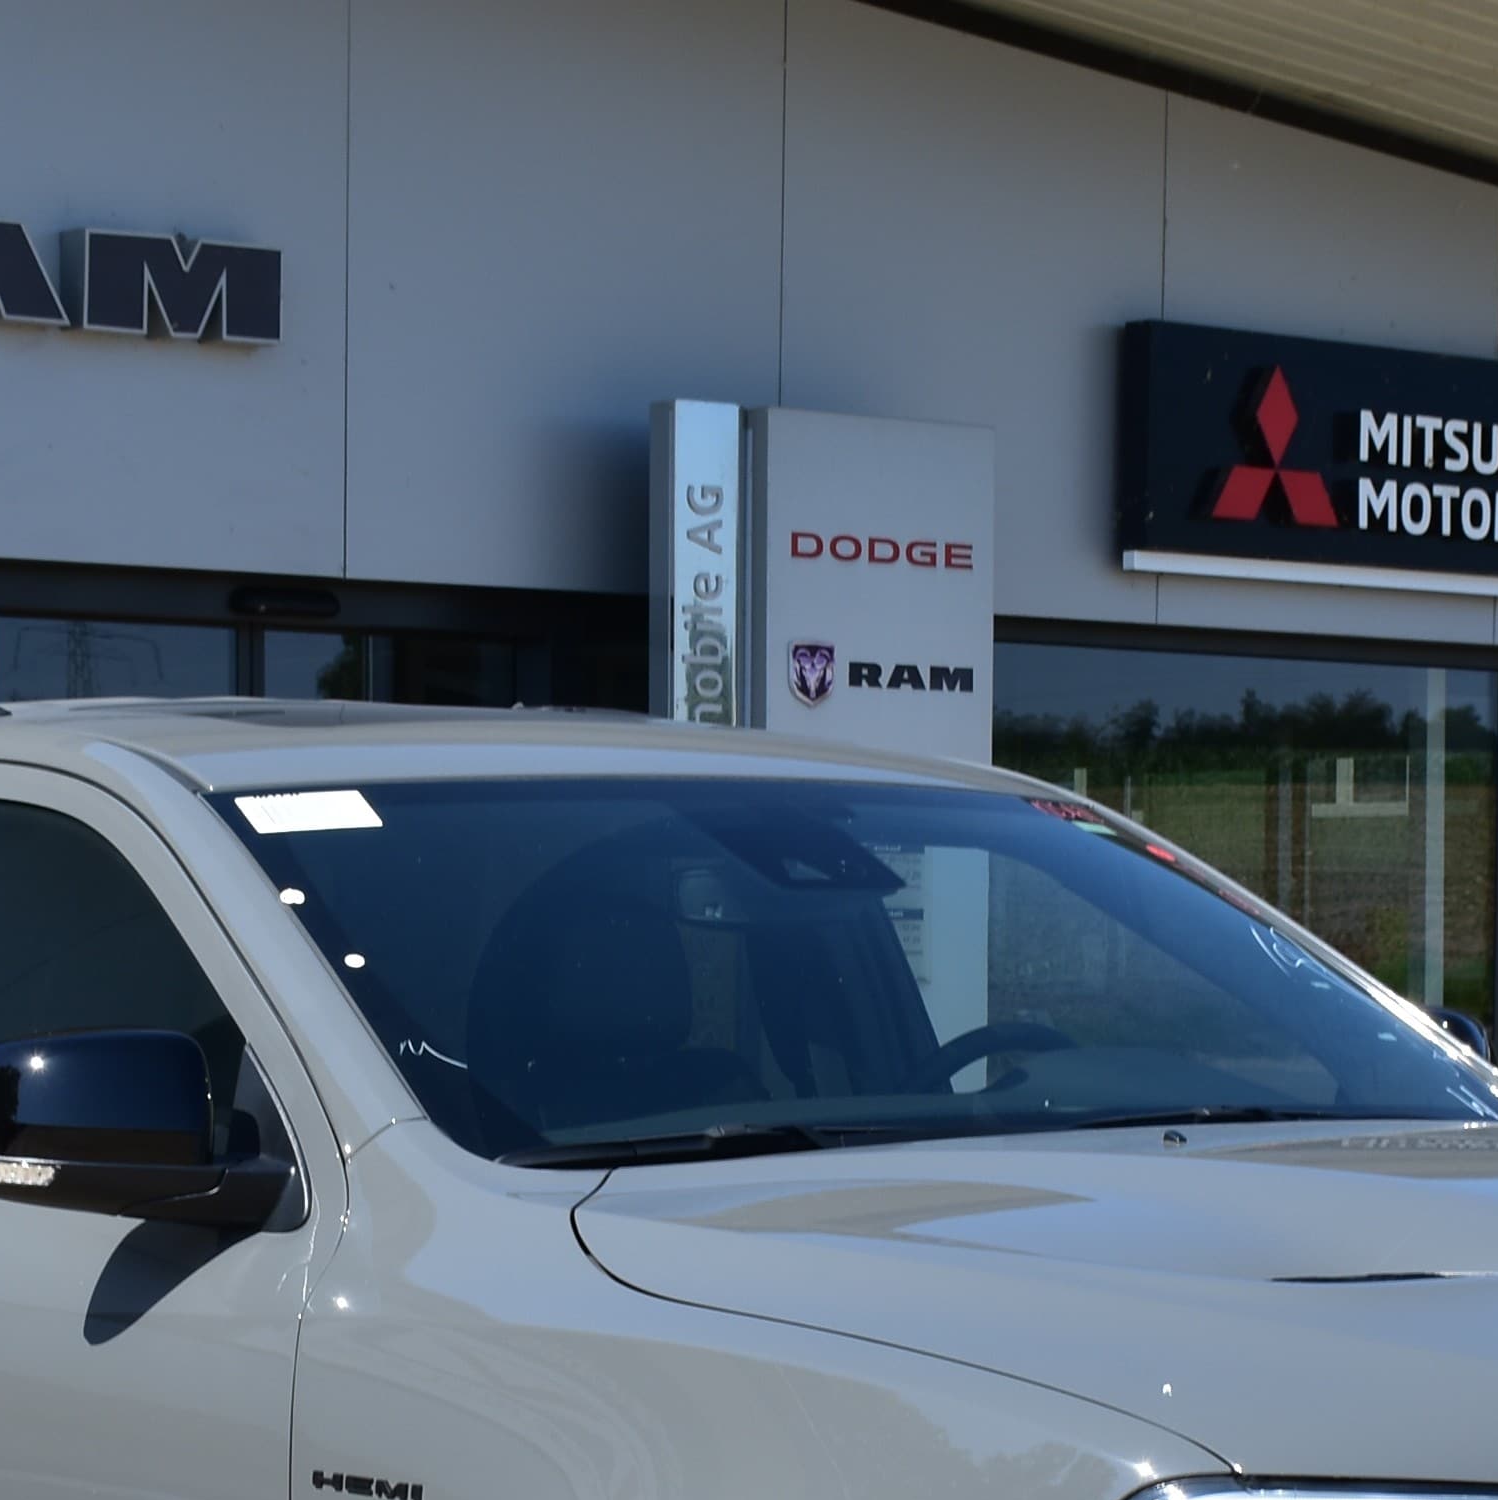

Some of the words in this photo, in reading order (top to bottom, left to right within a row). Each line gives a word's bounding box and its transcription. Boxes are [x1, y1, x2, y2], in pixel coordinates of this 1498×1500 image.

[685, 484, 724, 555] AG
[790, 531, 974, 571] DODGE
[847, 661, 974, 693] RAM
